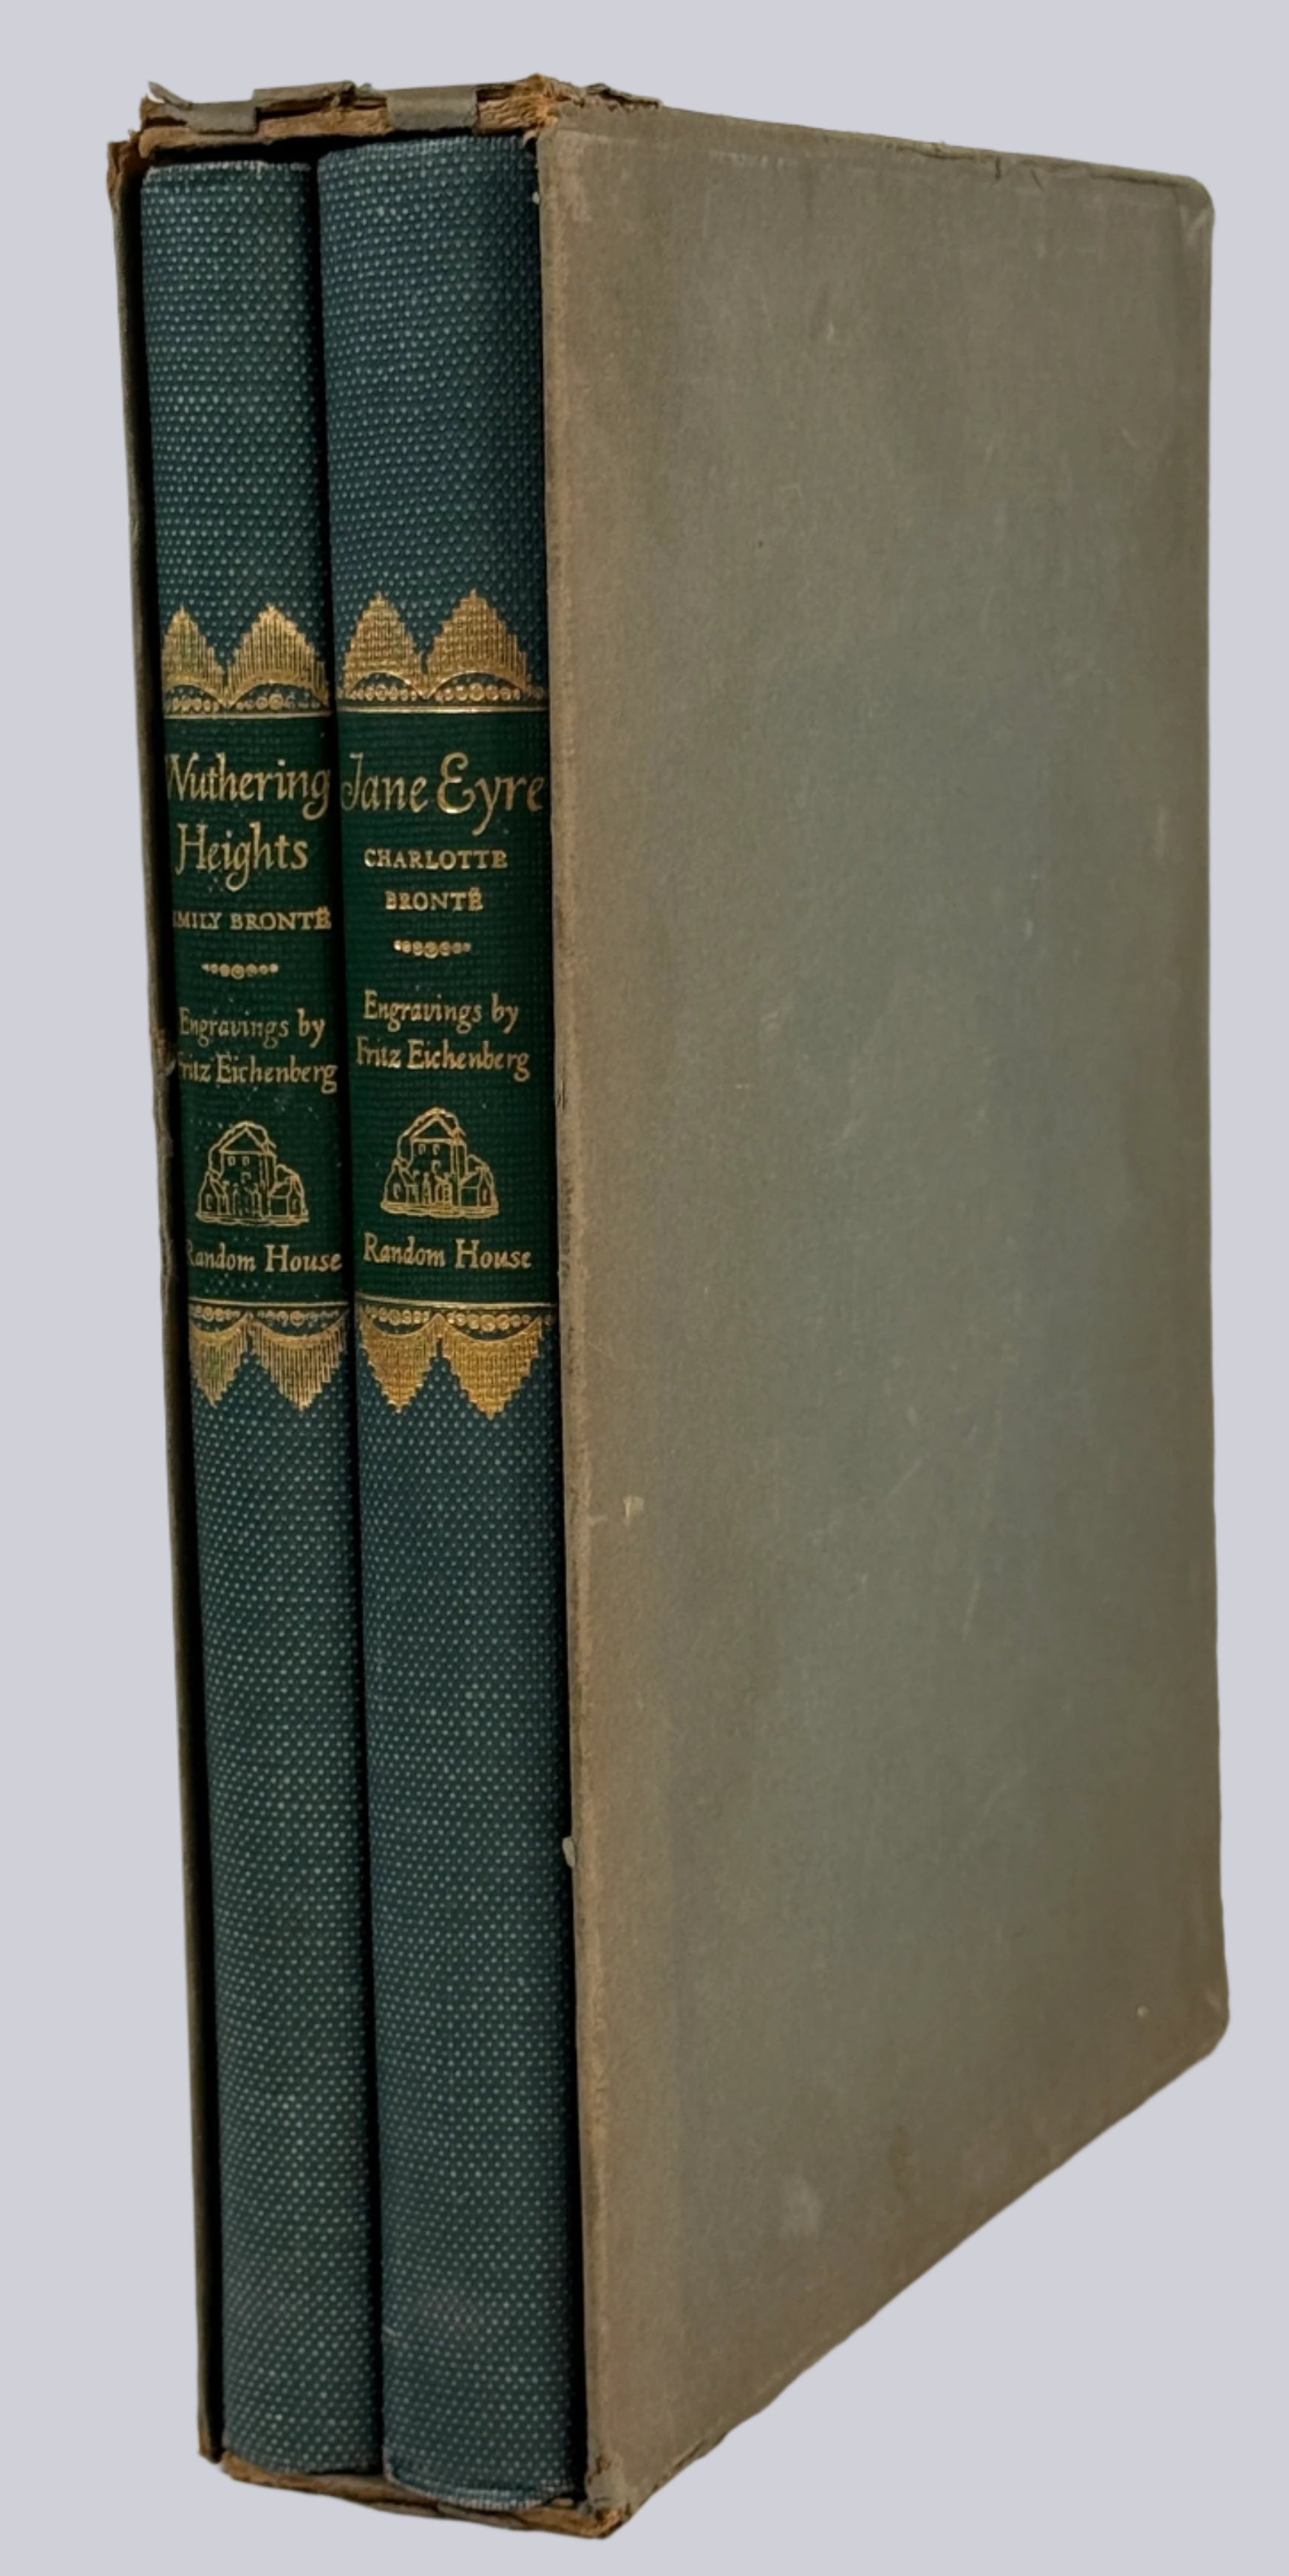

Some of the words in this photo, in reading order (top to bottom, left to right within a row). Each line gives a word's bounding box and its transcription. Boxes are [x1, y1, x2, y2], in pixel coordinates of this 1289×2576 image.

[341, 752, 429, 812] Jane
[437, 752, 545, 836] Eyre
[175, 822, 308, 892] Heights
[364, 849, 508, 869] CHARLOTTE
[172, 910, 222, 930] MILY
[229, 906, 332, 930] BRONTË
[385, 887, 483, 912] BRONTË
[179, 1006, 289, 1049] Engravings
[297, 1008, 325, 1049] by
[364, 989, 482, 1034] Engravings
[491, 992, 519, 1034] by
[178, 1052, 211, 1083] ritz
[216, 1054, 337, 1094] Eichenberg
[356, 1035, 402, 1069] Fritz
[407, 1038, 530, 1082] Eichenberg
[265, 1244, 342, 1272] House
[363, 1233, 446, 1267] Random
[455, 1238, 531, 1269] House
